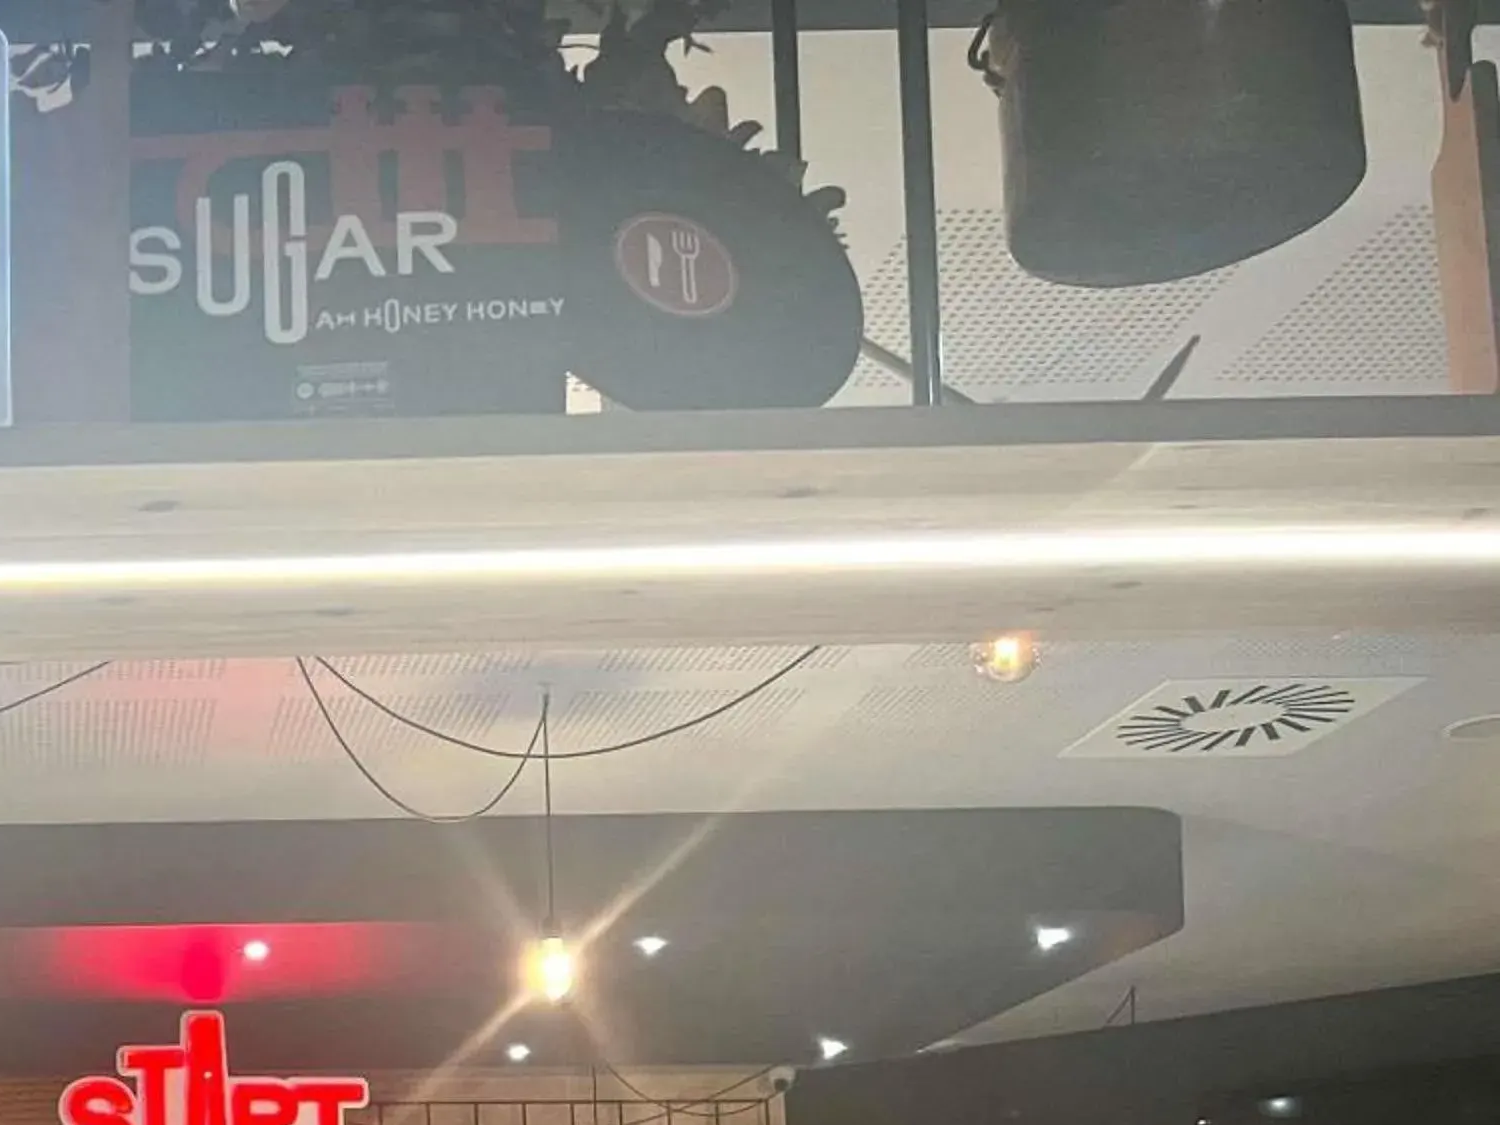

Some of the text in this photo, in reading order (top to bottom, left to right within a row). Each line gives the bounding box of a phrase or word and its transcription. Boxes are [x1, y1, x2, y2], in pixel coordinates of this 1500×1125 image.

[128, 160, 458, 344] SUGAR
[316, 299, 565, 333] AH HONEY HONEY
